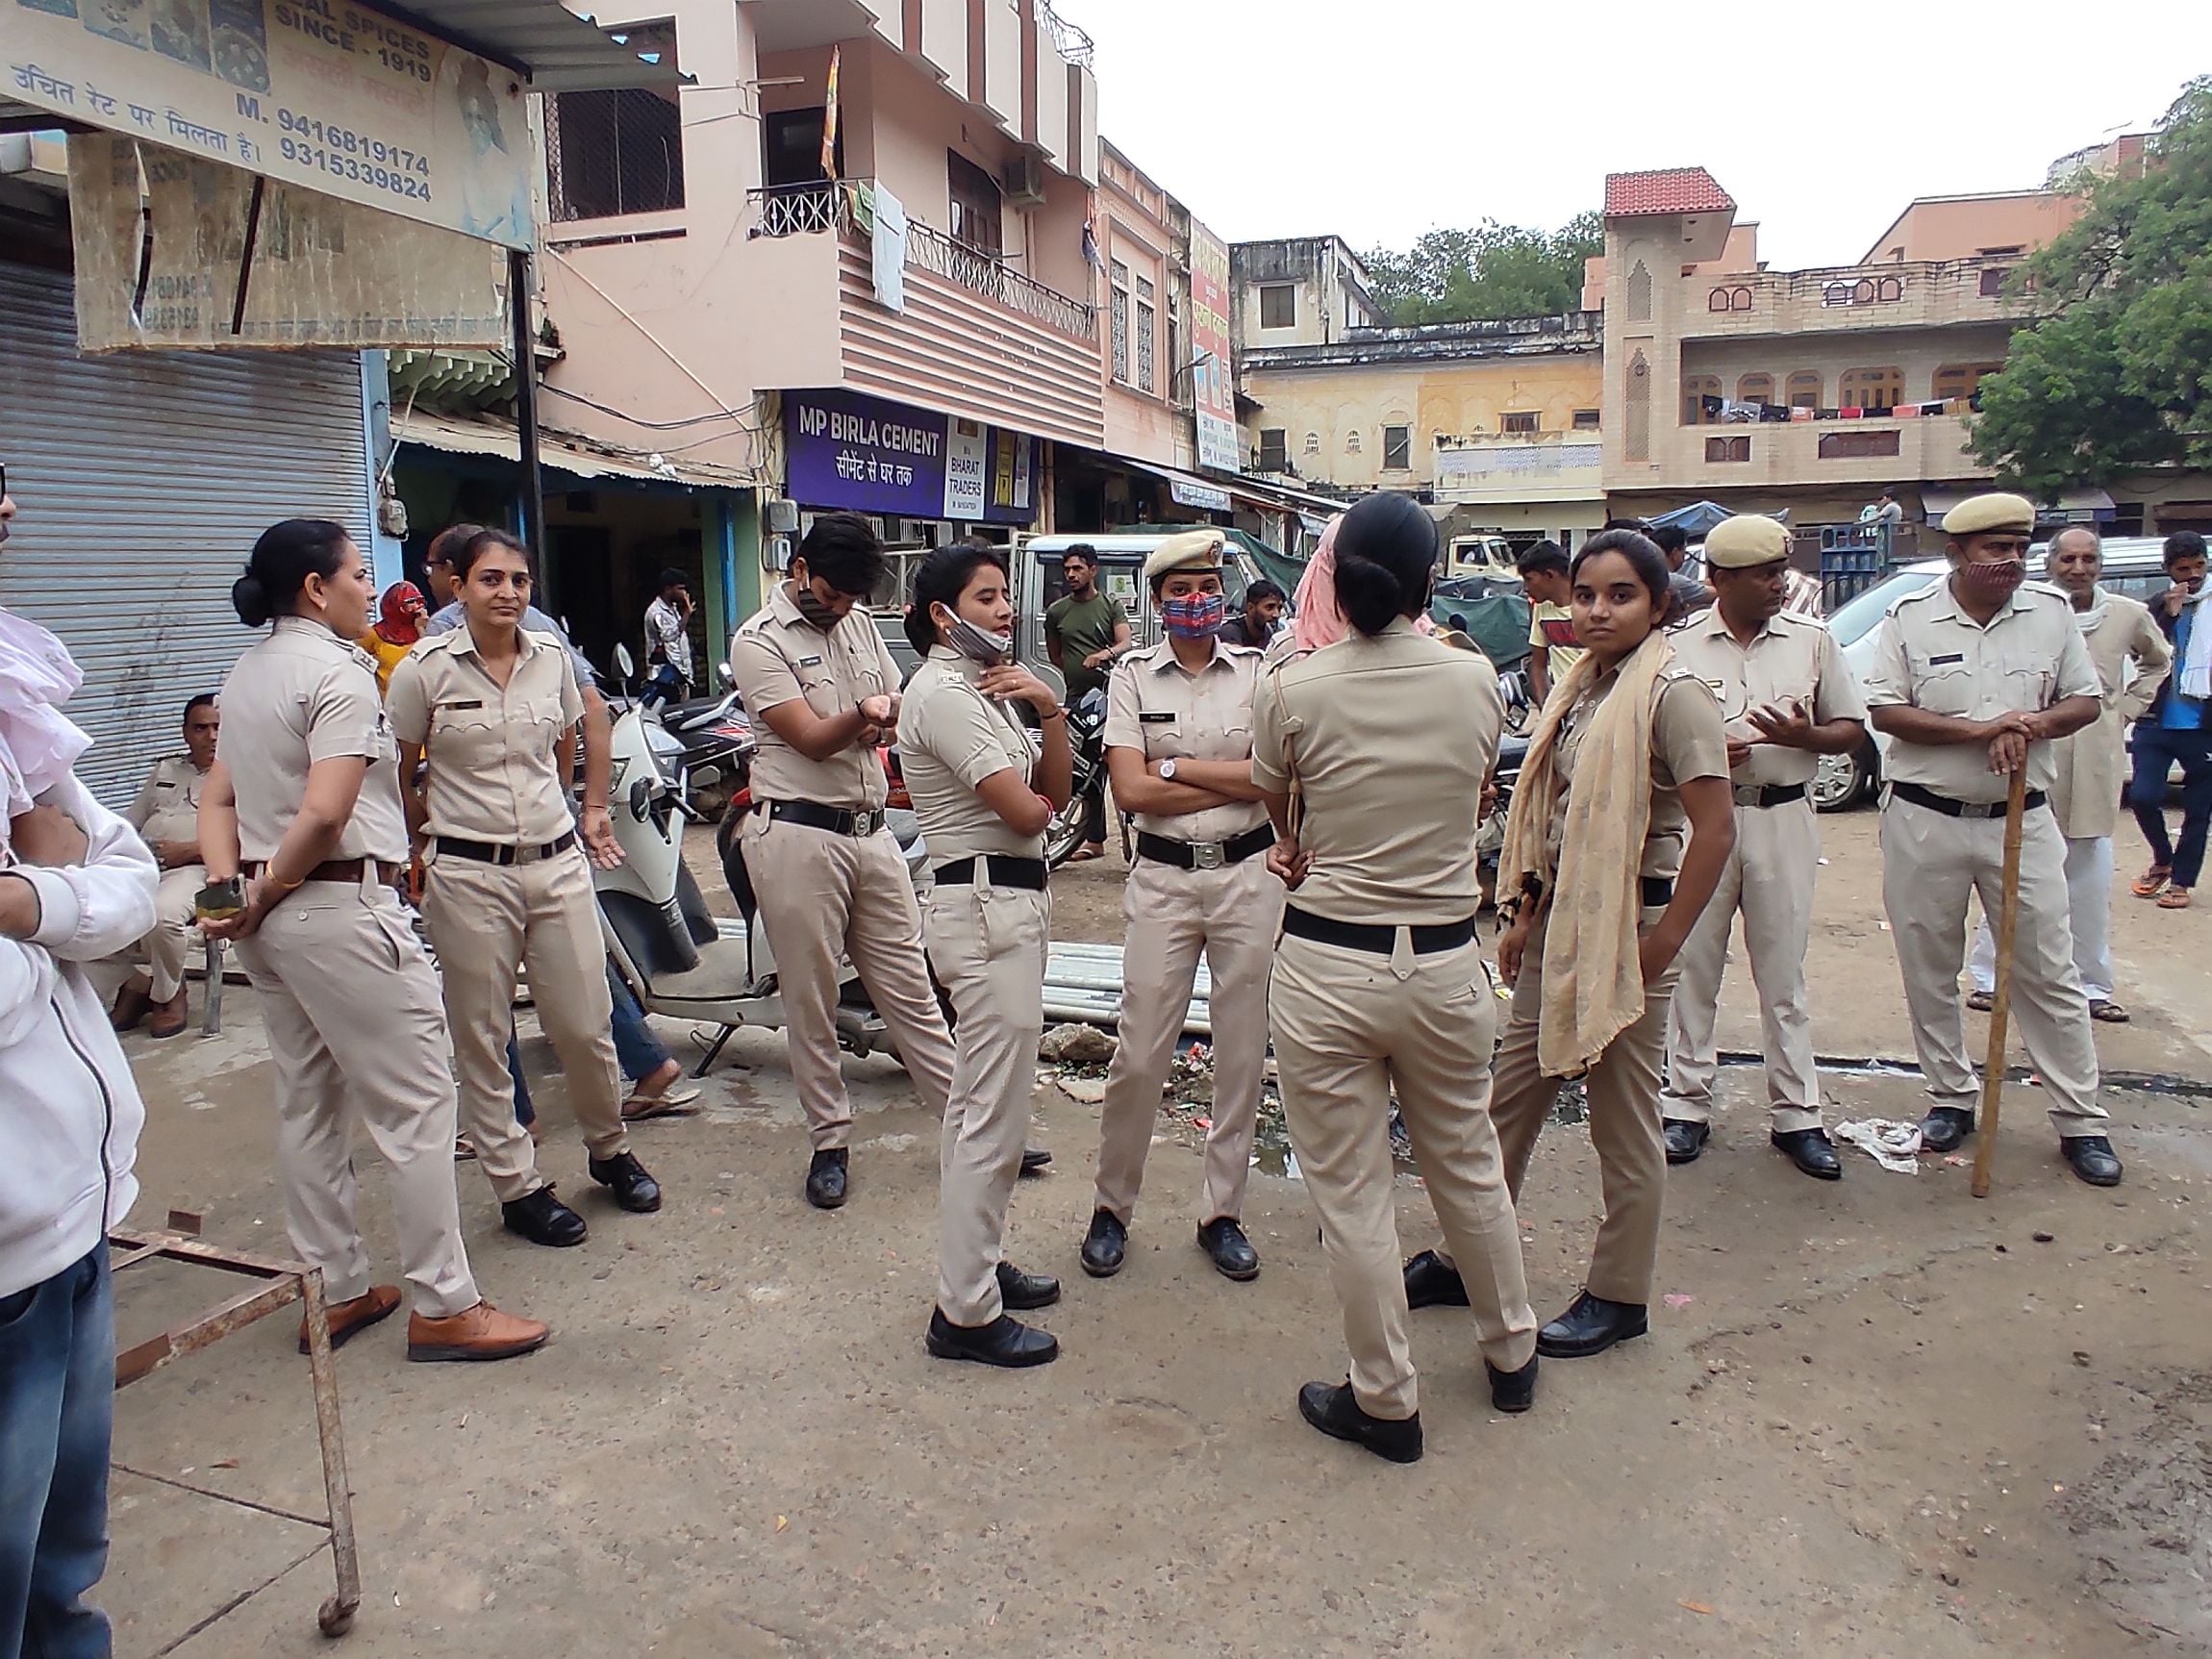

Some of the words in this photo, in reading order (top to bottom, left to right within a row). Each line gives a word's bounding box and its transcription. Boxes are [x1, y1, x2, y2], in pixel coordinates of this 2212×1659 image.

[275, 4, 356, 54] SINCE
[378, 46, 431, 83] 1919
[344, 10, 430, 60] SPICES
[11, 63, 75, 105] उचित
[85, 81, 117, 115] रेट
[127, 103, 156, 130] पर
[164, 105, 228, 152] मिलता
[236, 92, 269, 123] M.
[277, 108, 430, 177] 9416819174
[280, 137, 432, 202] 9315339824
[799, 405, 827, 437] MP
[831, 412, 880, 447] BIRLA
[882, 423, 940, 457] CEMENT
[836, 449, 865, 481] सीमेंट
[867, 453, 877, 482] से
[880, 463, 893, 486] घर
[896, 465, 913, 487] तक
[949, 478, 982, 496] TRADERS
[951, 457, 980, 475] BHARAT
